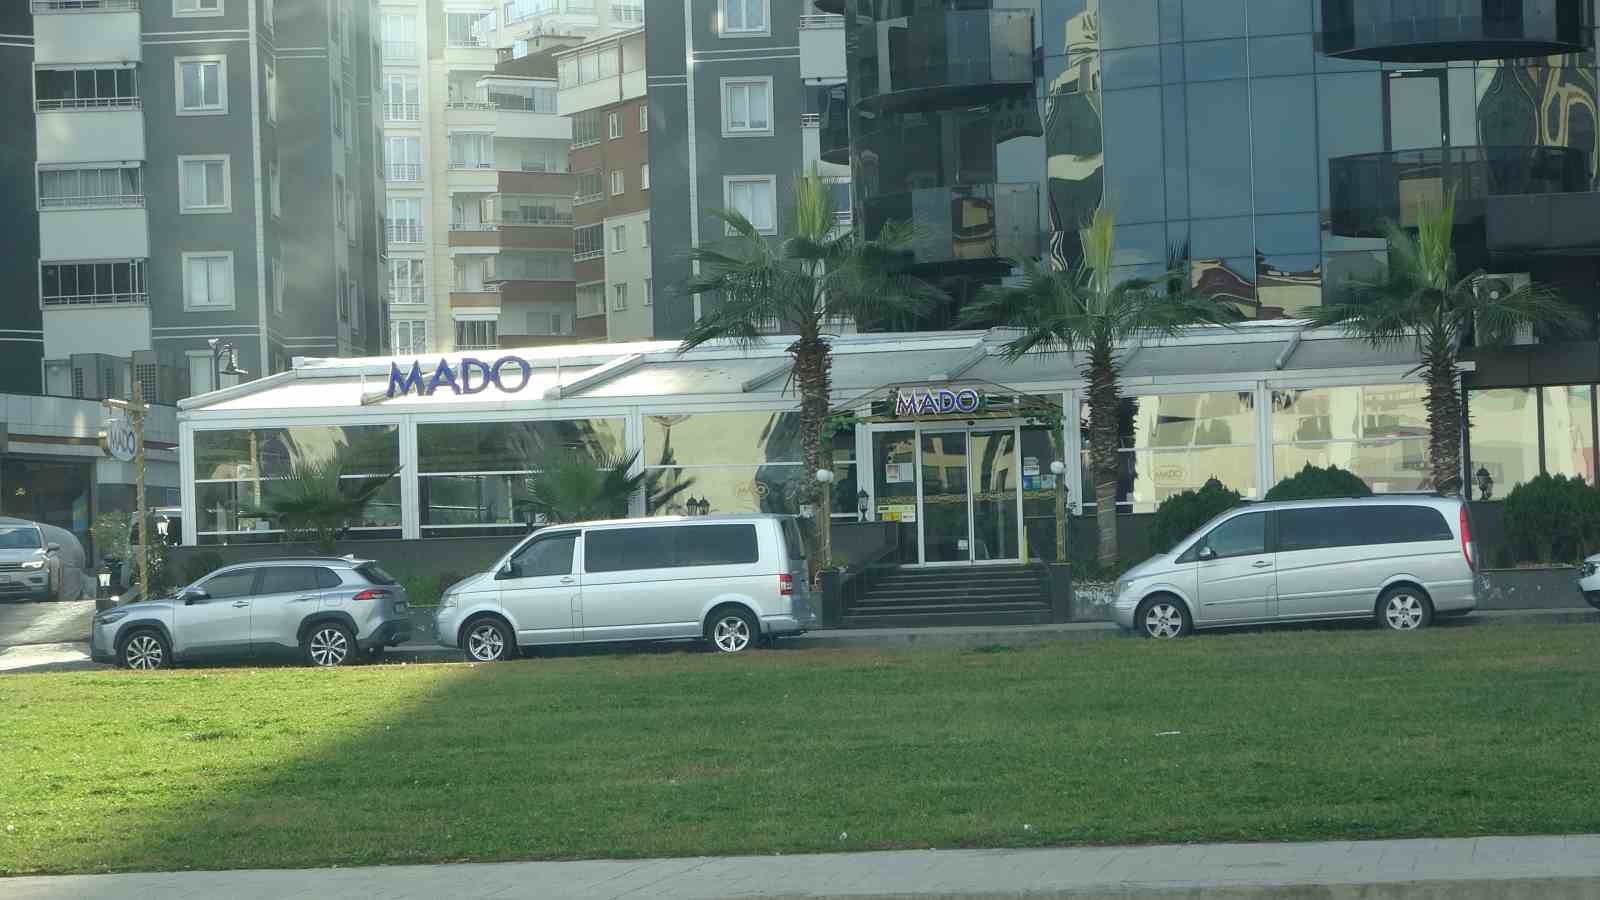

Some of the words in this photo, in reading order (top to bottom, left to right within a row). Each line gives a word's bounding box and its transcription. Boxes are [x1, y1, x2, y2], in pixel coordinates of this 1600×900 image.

[386, 355, 531, 398] MADO
[896, 388, 979, 416] MADO
[110, 430, 135, 455] MADO
